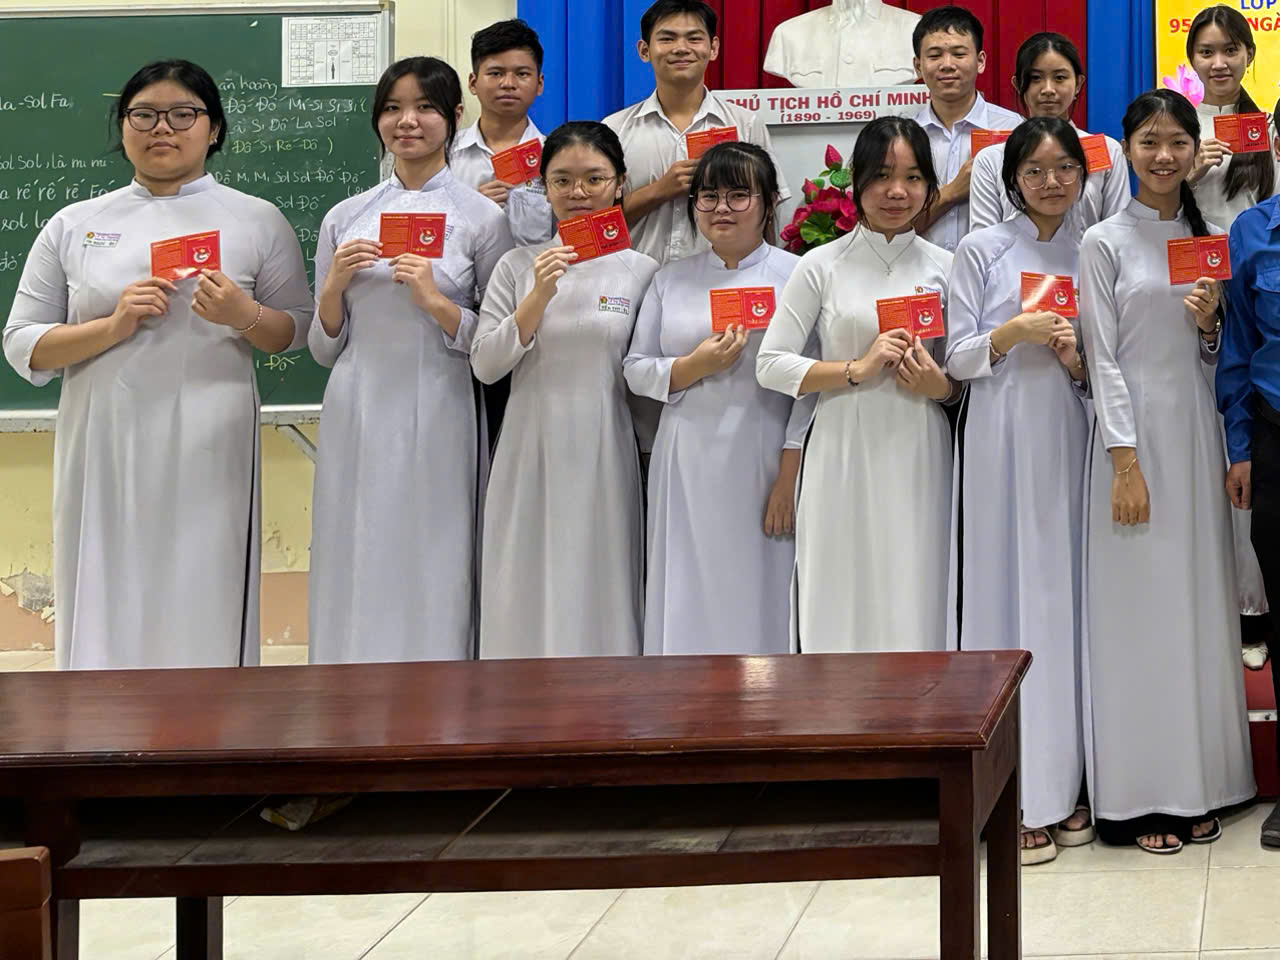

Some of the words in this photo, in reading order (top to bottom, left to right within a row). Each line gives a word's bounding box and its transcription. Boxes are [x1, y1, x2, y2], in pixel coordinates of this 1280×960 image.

[1169, 18, 1192, 34] 95
[768, 96, 811, 112] TỊCH
[817, 90, 842, 109] HỒ
[849, 93, 880, 107] CHÍ
[887, 92, 931, 106] MINH
[780, 112, 821, 124] (1890
[838, 110, 877, 122] 1969)
